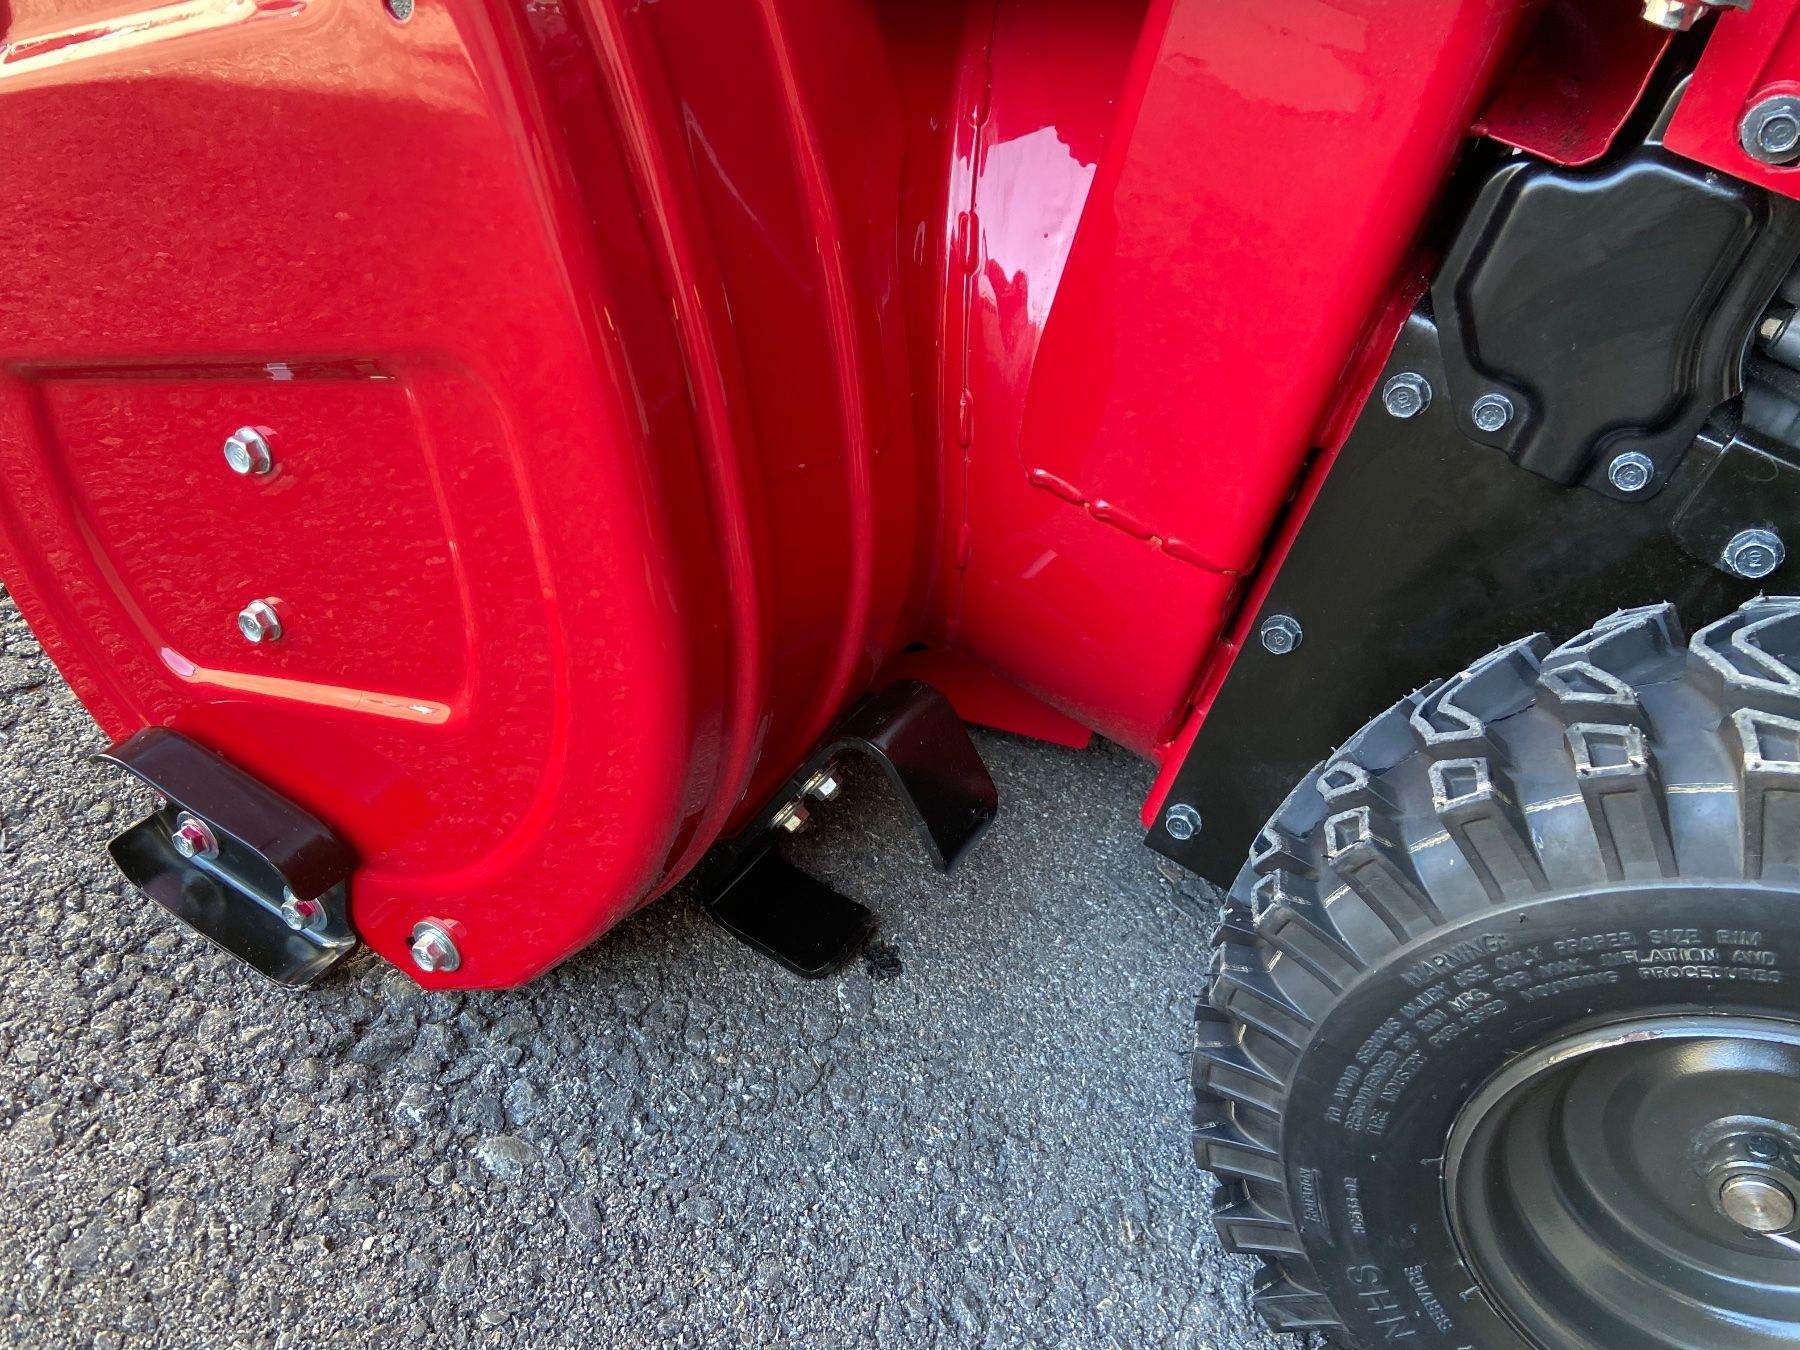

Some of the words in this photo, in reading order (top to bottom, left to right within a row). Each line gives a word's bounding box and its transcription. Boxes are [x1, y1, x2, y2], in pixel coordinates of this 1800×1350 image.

[1324, 1105, 1343, 1123] TO
[1356, 1017, 1401, 1063] SERIOUS
[1400, 981, 1449, 1019] INJURY
[1453, 964, 1491, 987] USE
[1495, 946, 1544, 970] ONLY
[1553, 931, 1639, 955] PROPER
[1649, 928, 1703, 945] SIZE
[1716, 929, 1763, 946] RIM
[1344, 1050, 1400, 1132] RECOMMENDED
[1416, 1008, 1448, 1032] RIM
[1492, 970, 1532, 990] FOR
[1600, 947, 1720, 966] INFLATION
[1732, 950, 1778, 966] AND
[1366, 1108, 1390, 1136] TIRE
[1381, 1049, 1428, 1103] INDUSTRY
[1519, 970, 1619, 1000] MOUNTING
[1638, 966, 1783, 983] PROCEDURES
[1346, 1263, 1417, 1339] NHS
[1403, 1264, 1454, 1335] SERVICE
